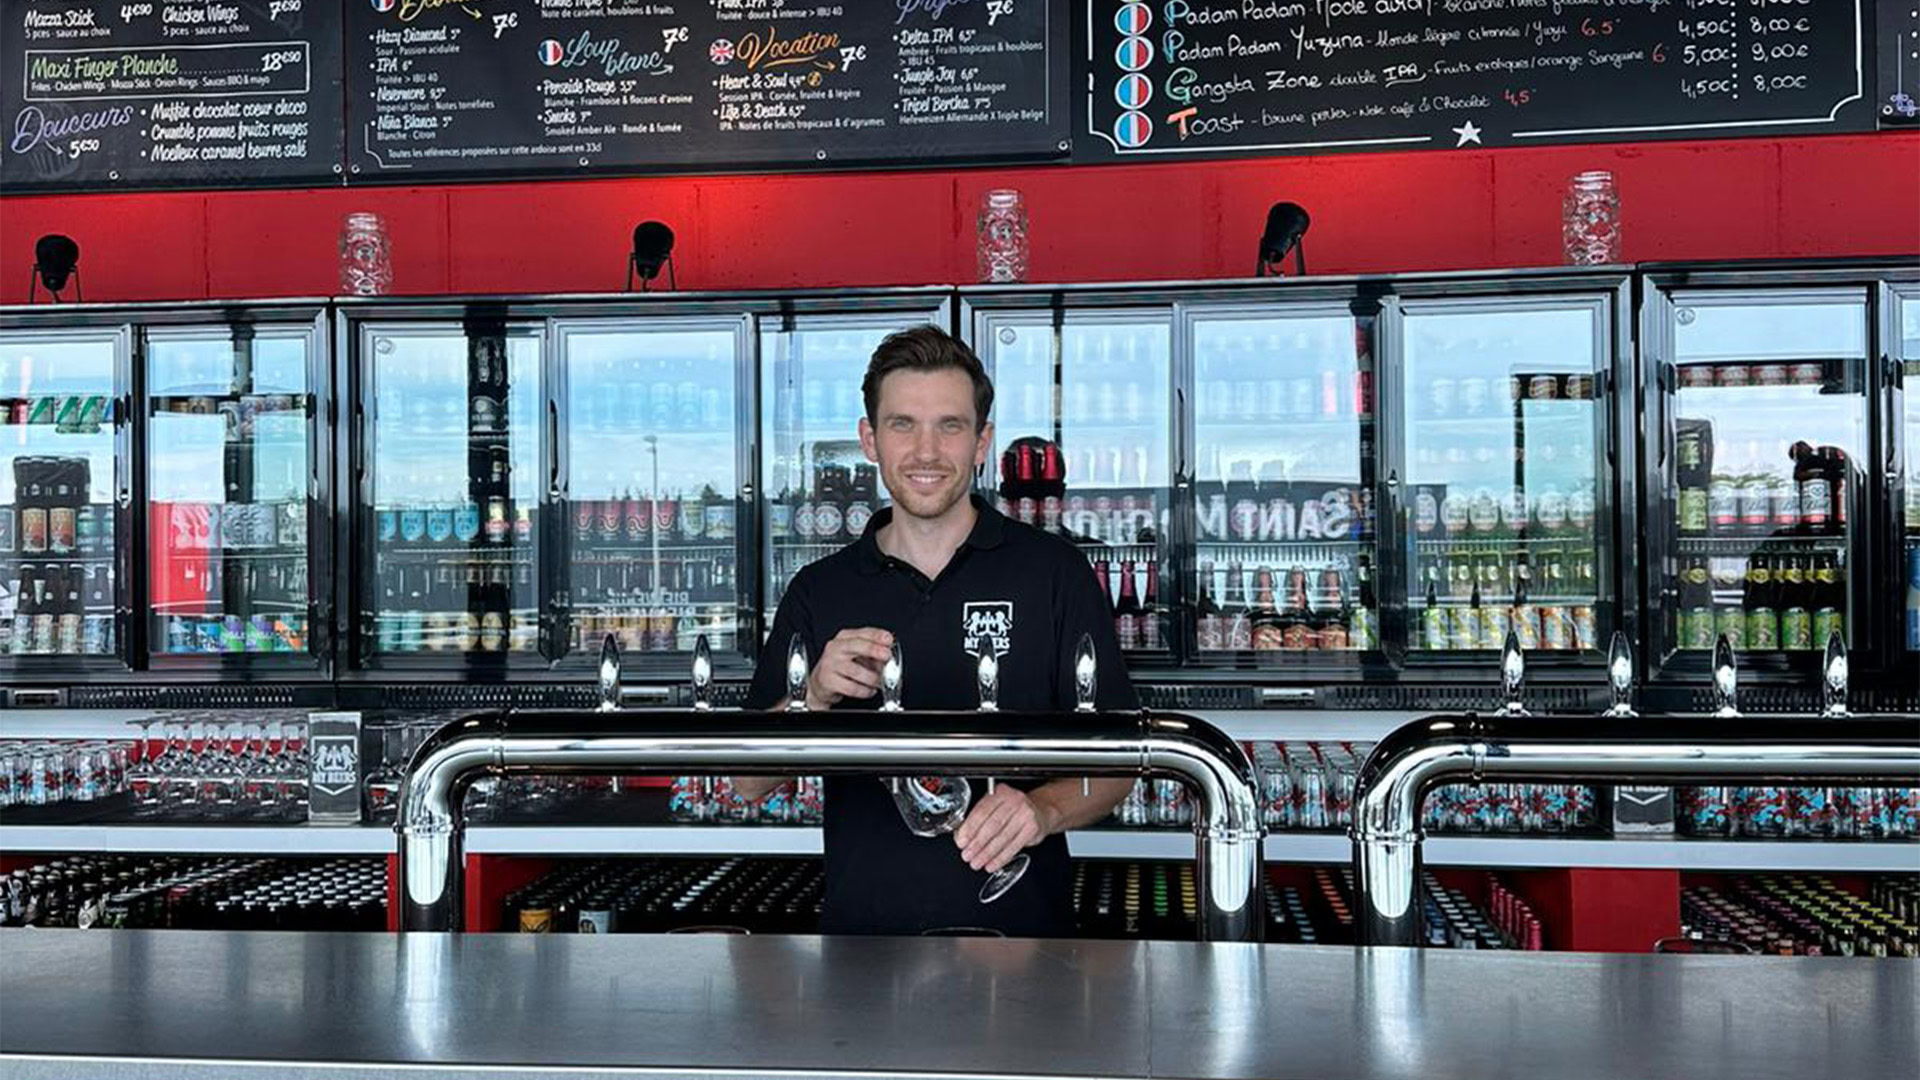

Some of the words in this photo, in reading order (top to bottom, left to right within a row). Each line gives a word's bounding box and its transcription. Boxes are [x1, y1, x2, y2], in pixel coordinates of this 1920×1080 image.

[65, 8, 95, 27] Stick
[162, 5, 205, 23] Chicken
[207, 4, 239, 24] Wings
[986, 0, 1014, 26] 7€
[1164, 0, 1238, 27] Padam
[1242, 0, 1305, 20] Padam
[26, 29, 31, 39] 5
[33, 28, 50, 40] pces
[56, 28, 78, 38] sauce
[80, 29, 88, 37] au
[90, 27, 111, 36] choix
[163, 26, 169, 35] 5
[170, 25, 189, 37] pces
[195, 24, 216, 35] sauce
[218, 24, 227, 34] au
[229, 23, 250, 33] choix
[403, 26, 447, 43] Diamond
[493, 12, 518, 39] 7€
[932, 27, 954, 43] IPA
[562, 30, 620, 68] Loup
[605, 51, 663, 76] blanc
[662, 27, 689, 53] 7€
[737, 26, 841, 70] Vocation
[1163, 30, 1224, 64] Padam
[1228, 34, 1281, 57] Padam
[31, 58, 71, 80] Maxi
[75, 57, 118, 82] Finger
[122, 54, 179, 76] Planche
[261, 51, 301, 72] 18€90
[376, 58, 398, 73] IPA
[840, 45, 867, 72] 7€
[720, 74, 749, 90] Heart
[764, 73, 787, 88] Soul
[936, 66, 956, 84] Joy
[1165, 67, 1255, 105] Gangsta
[1266, 71, 1323, 91] Zone
[1329, 70, 1377, 86] double
[1383, 64, 1418, 81] IPA
[56, 82, 82, 91] Chicken
[83, 81, 105, 92] Wings
[151, 102, 190, 122] Muffin
[193, 102, 241, 118] chocolat
[275, 98, 307, 115] choco
[754, 102, 787, 118] Death
[12, 106, 134, 154] Douceurs
[151, 122, 195, 141] Crumble
[197, 125, 236, 142] pomme
[238, 121, 270, 140] fruits
[272, 122, 308, 139] rouges
[1166, 107, 1244, 141] Toast
[151, 144, 199, 162] Moelleux
[201, 142, 246, 159] caramel
[248, 142, 282, 159] beurre
[284, 140, 307, 157] salé
[964, 637, 980, 649] MY
